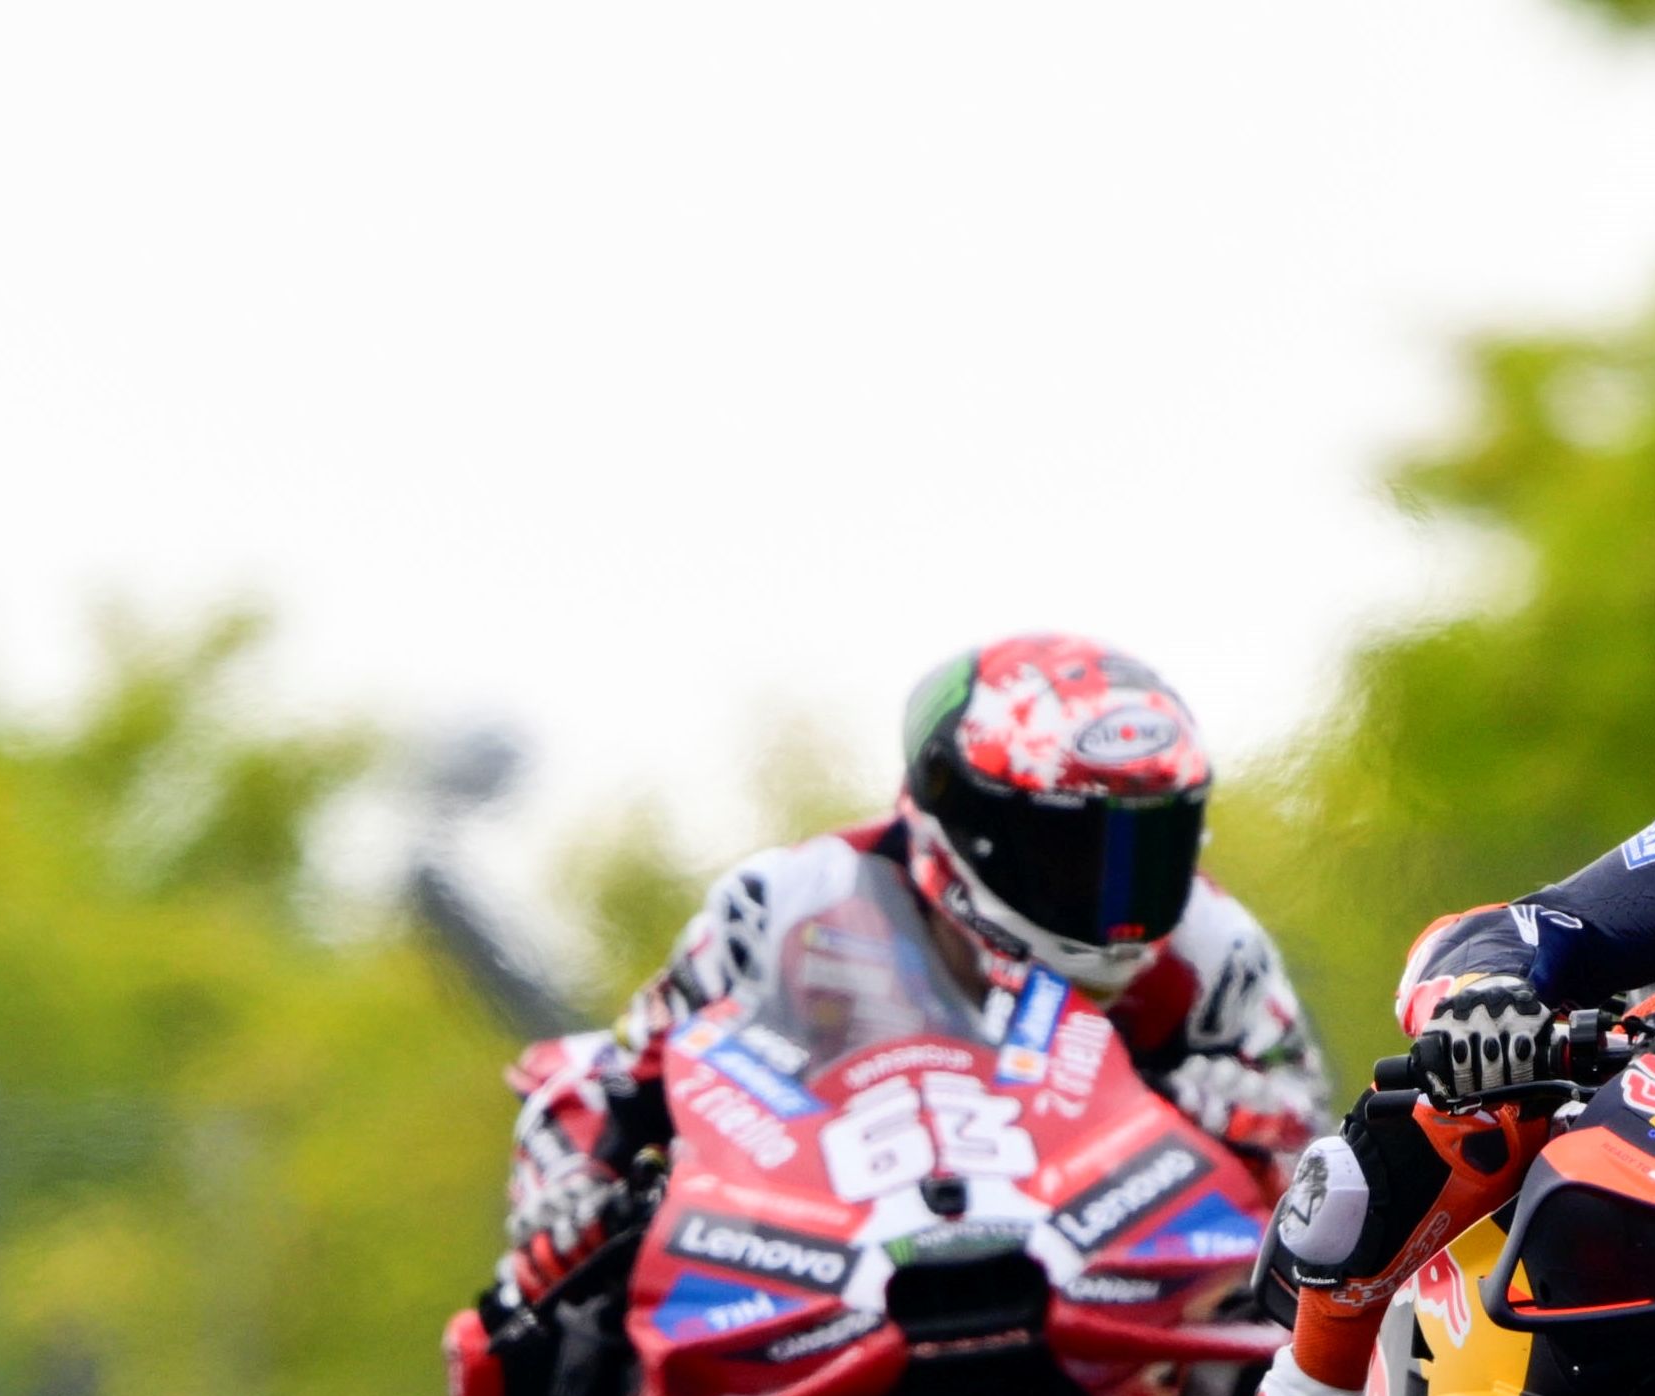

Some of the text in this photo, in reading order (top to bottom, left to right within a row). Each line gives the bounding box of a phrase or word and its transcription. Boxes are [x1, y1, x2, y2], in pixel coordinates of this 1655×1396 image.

[819, 1070, 1040, 1205] 63
[1055, 1149, 1197, 1246] Lenovo
[677, 1214, 846, 1284] Lenovo
